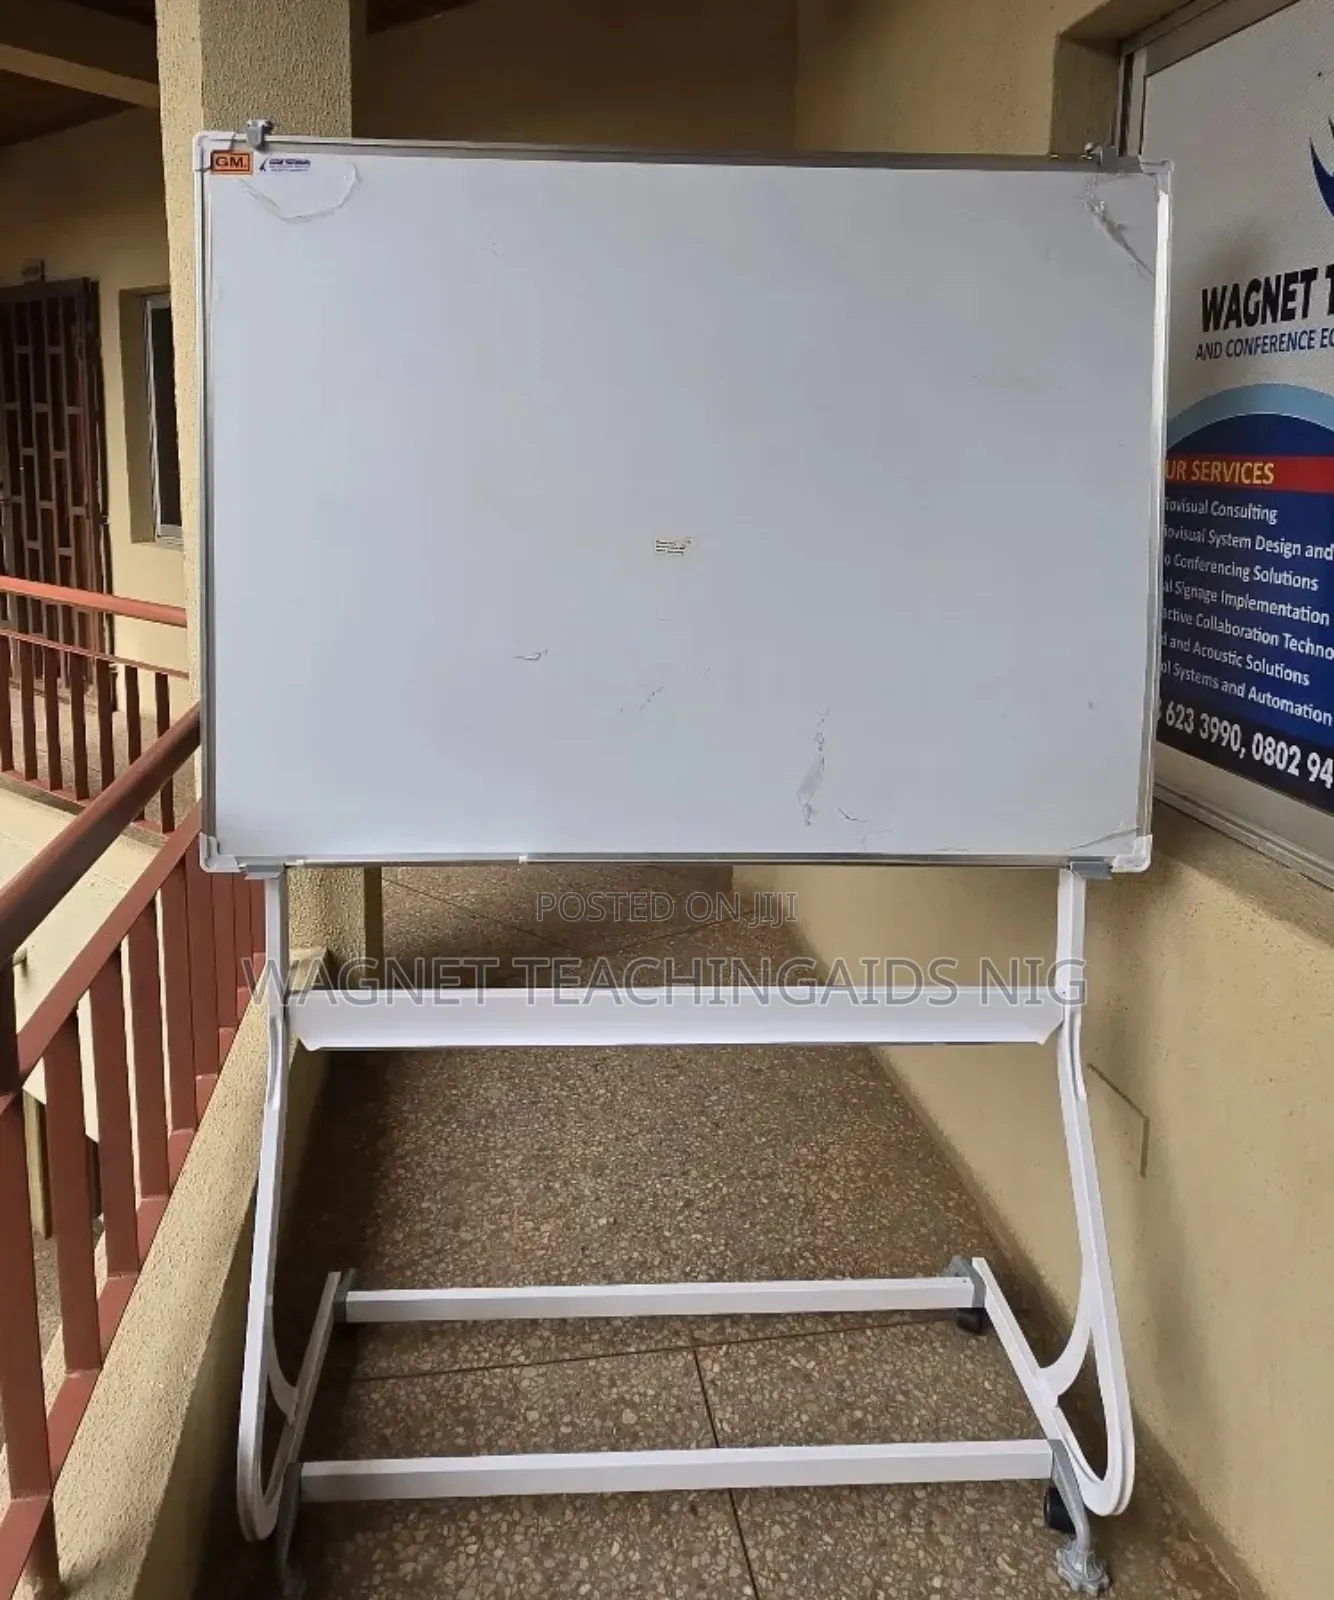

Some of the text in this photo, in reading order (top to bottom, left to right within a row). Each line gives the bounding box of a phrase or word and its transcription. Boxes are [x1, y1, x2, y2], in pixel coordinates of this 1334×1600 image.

[1201, 266, 1319, 333] WAGNET
[1195, 340, 1223, 361] AND
[1225, 329, 1317, 357] CONFERENCE
[1191, 460, 1275, 485] SERVICES
[1210, 500, 1278, 526] Consulting
[1208, 529, 1251, 549] System
[1255, 534, 1301, 560] Design
[1305, 543, 1334, 561] and
[1173, 553, 1251, 582] Conferencing
[1253, 564, 1319, 591] Solutions
[1174, 580, 1218, 604] Signage
[1221, 590, 1330, 627] Implementation
[1196, 613, 1279, 647] Collaboration
[1169, 637, 1191, 652] and
[1193, 641, 1243, 669] Acoustic
[1245, 654, 1311, 687] Solutions
[1173, 662, 1219, 689] Systems
[1221, 679, 1246, 698] and
[1248, 685, 1333, 727] Automation
[1166, 700, 1195, 734] 623
[1199, 712, 1246, 759] 3990,
[1251, 731, 1301, 777] 0802
